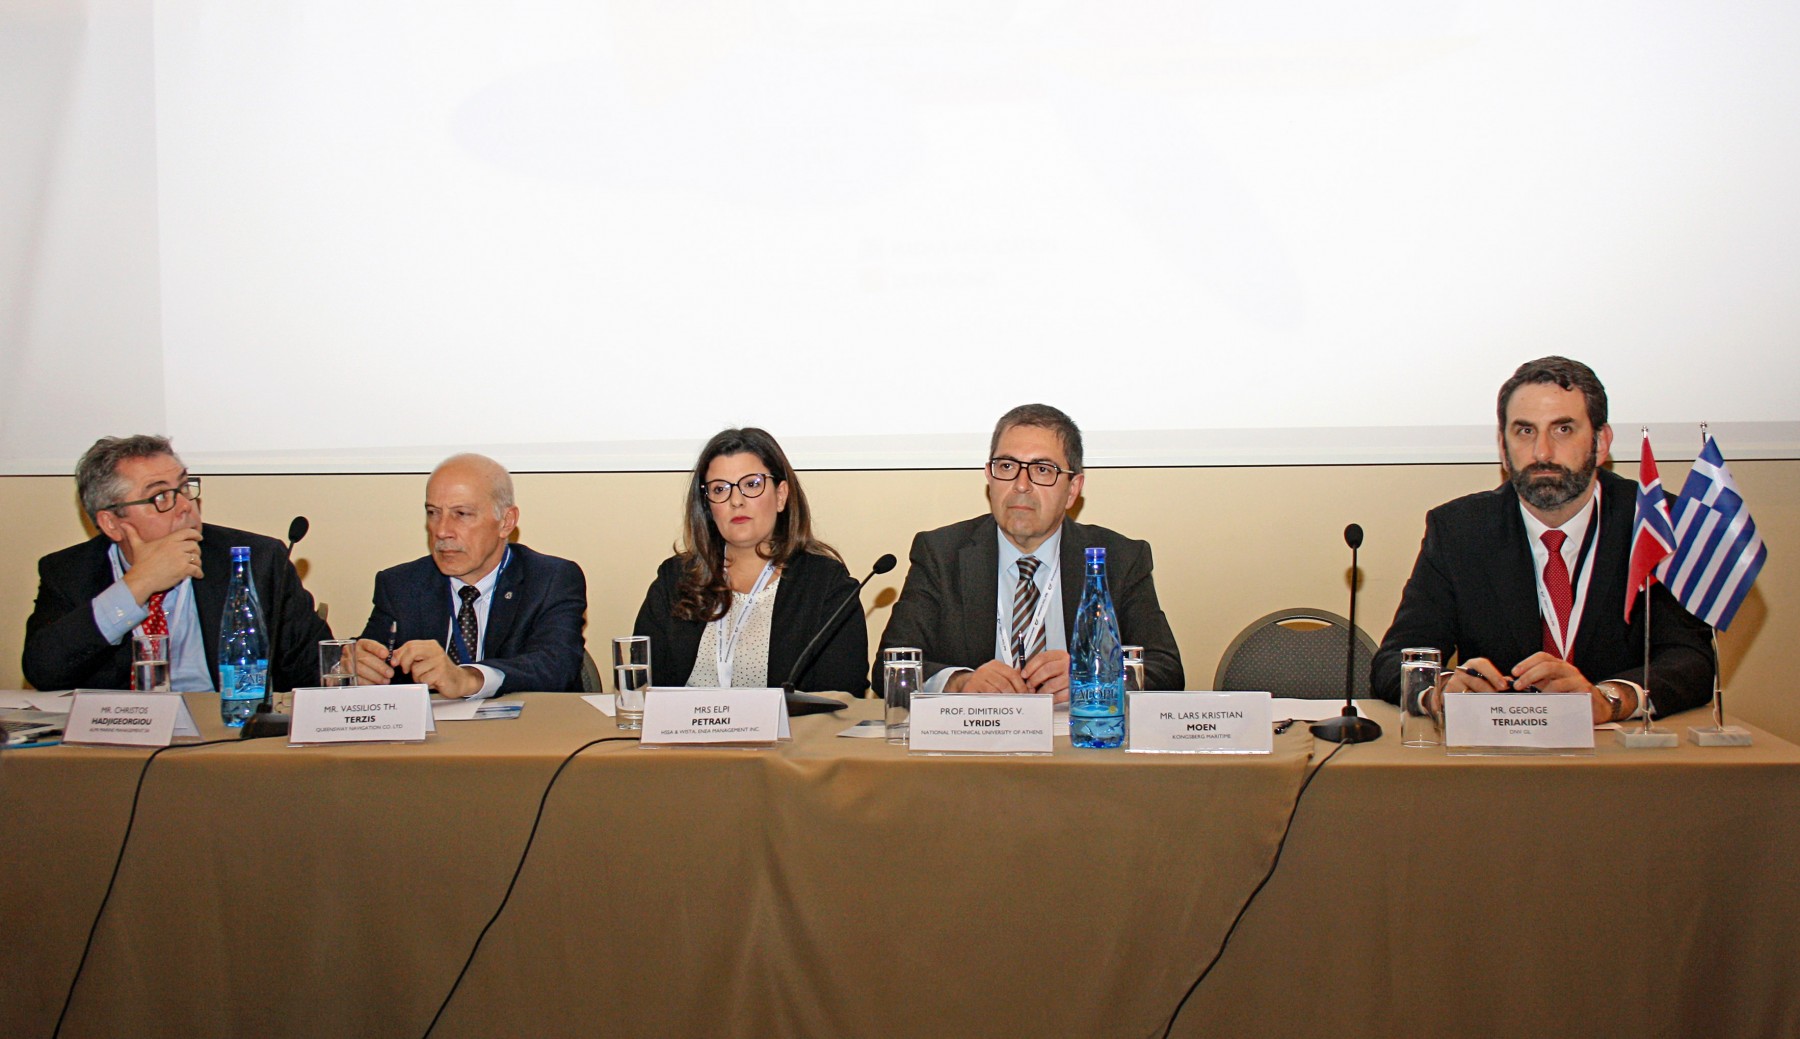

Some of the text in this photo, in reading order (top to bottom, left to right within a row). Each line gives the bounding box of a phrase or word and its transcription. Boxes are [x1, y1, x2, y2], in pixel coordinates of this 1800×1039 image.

[101, 706, 149, 714] MR. CHRISTOS
[324, 703, 397, 713] MR. VASSILIOS TH.
[694, 705, 730, 714] MRS ELPI
[940, 707, 1024, 715] PROF. DIMITRIOS V.
[1490, 706, 1548, 714] MR. GEORGE
[345, 715, 376, 723] TERZIS
[1160, 711, 1243, 720] MR. LARS KRISTIAN
[91, 717, 152, 727] HADJIGEORGIOU
[691, 717, 731, 726] PETRAKI
[963, 719, 1001, 727] LYRIDIS
[1491, 718, 1548, 726] TERIAKIDIS
[1186, 723, 1217, 731] MOEN
